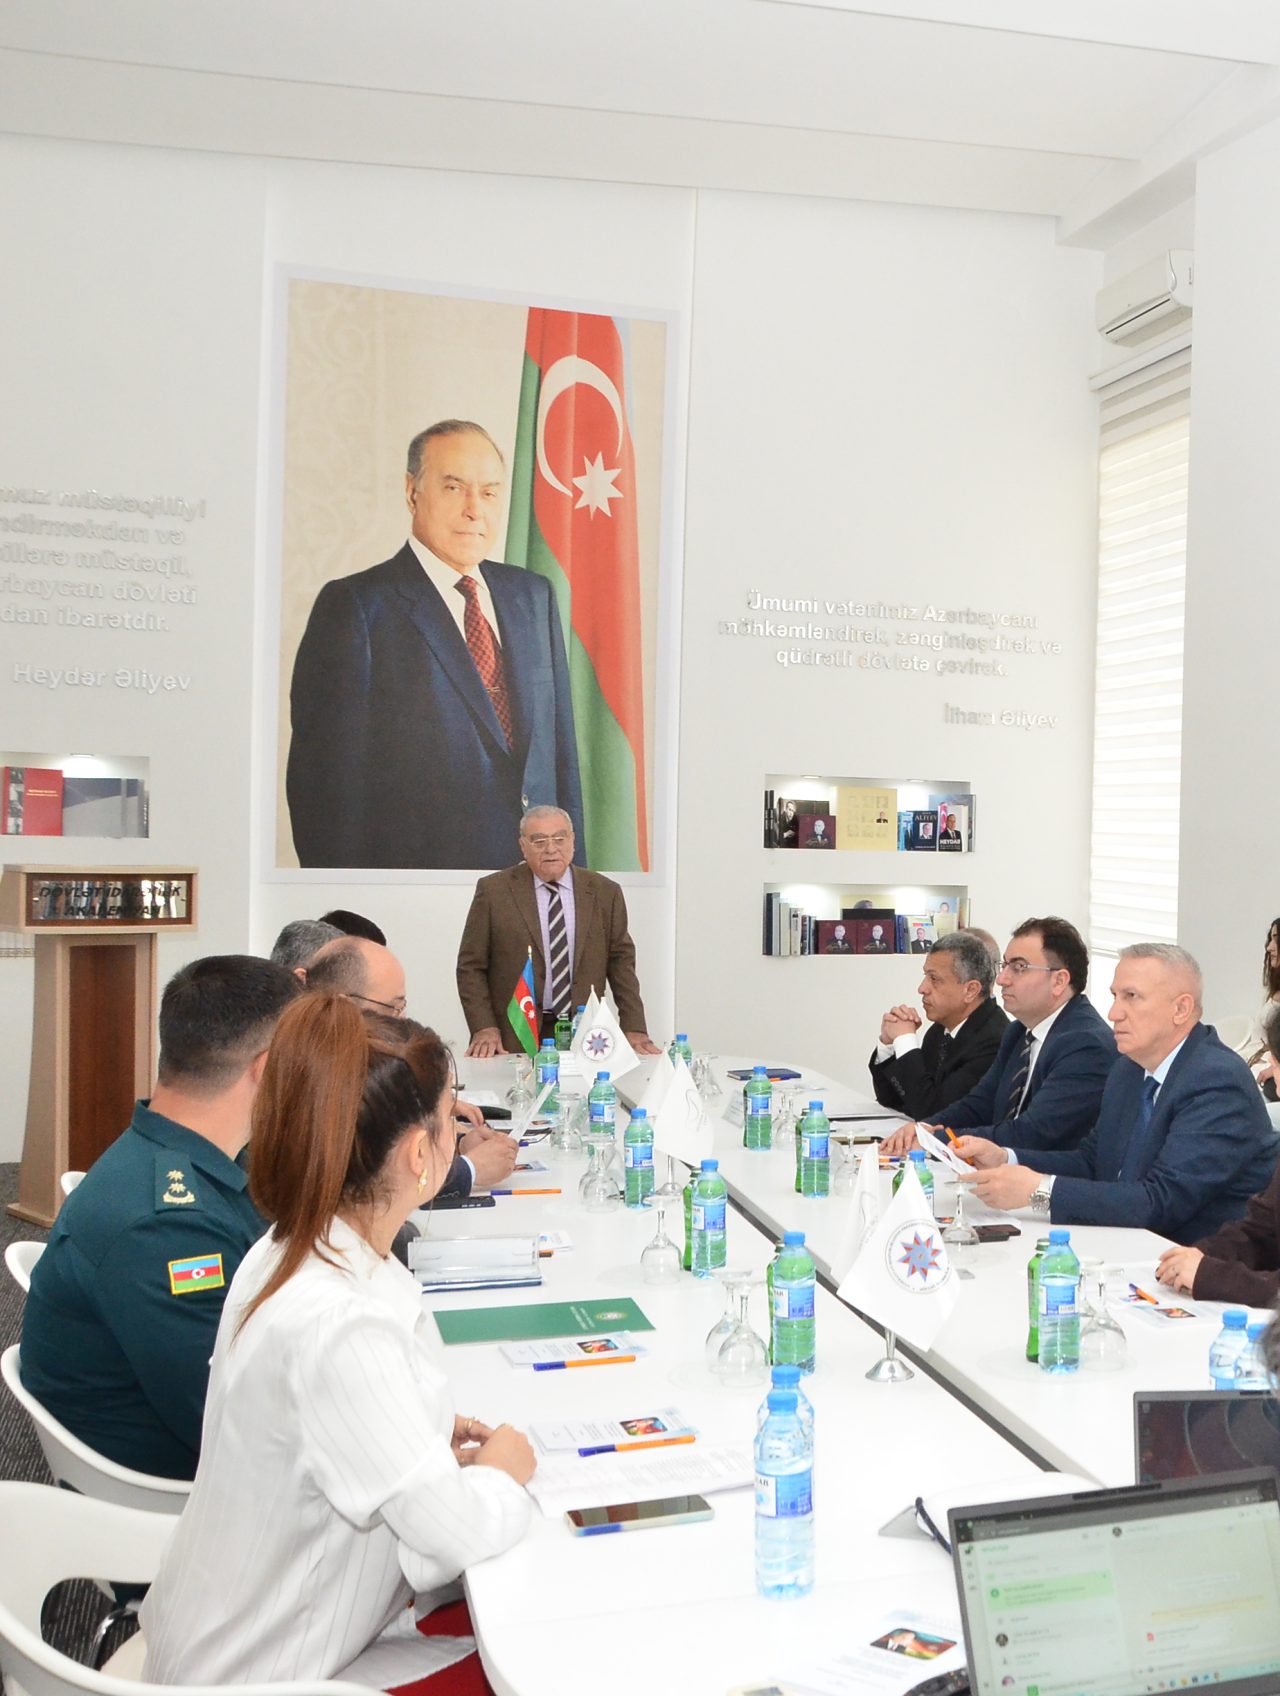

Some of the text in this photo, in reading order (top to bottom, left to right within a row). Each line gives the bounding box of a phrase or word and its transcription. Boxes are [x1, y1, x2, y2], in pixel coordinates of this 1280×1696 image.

[155, 529, 184, 545] və
[113, 581, 198, 604] dövləti
[748, 588, 1039, 630] Ümumi vətənimiz Azərbaycanı
[718, 617, 890, 647] möhkəmləndirək,
[1041, 639, 1063, 654] və
[776, 648, 853, 667] qüdrətli
[858, 650, 930, 671] dövlətə
[13, 663, 192, 694] Heydər Əliyev
[1000, 708, 1059, 731] Əliyev
